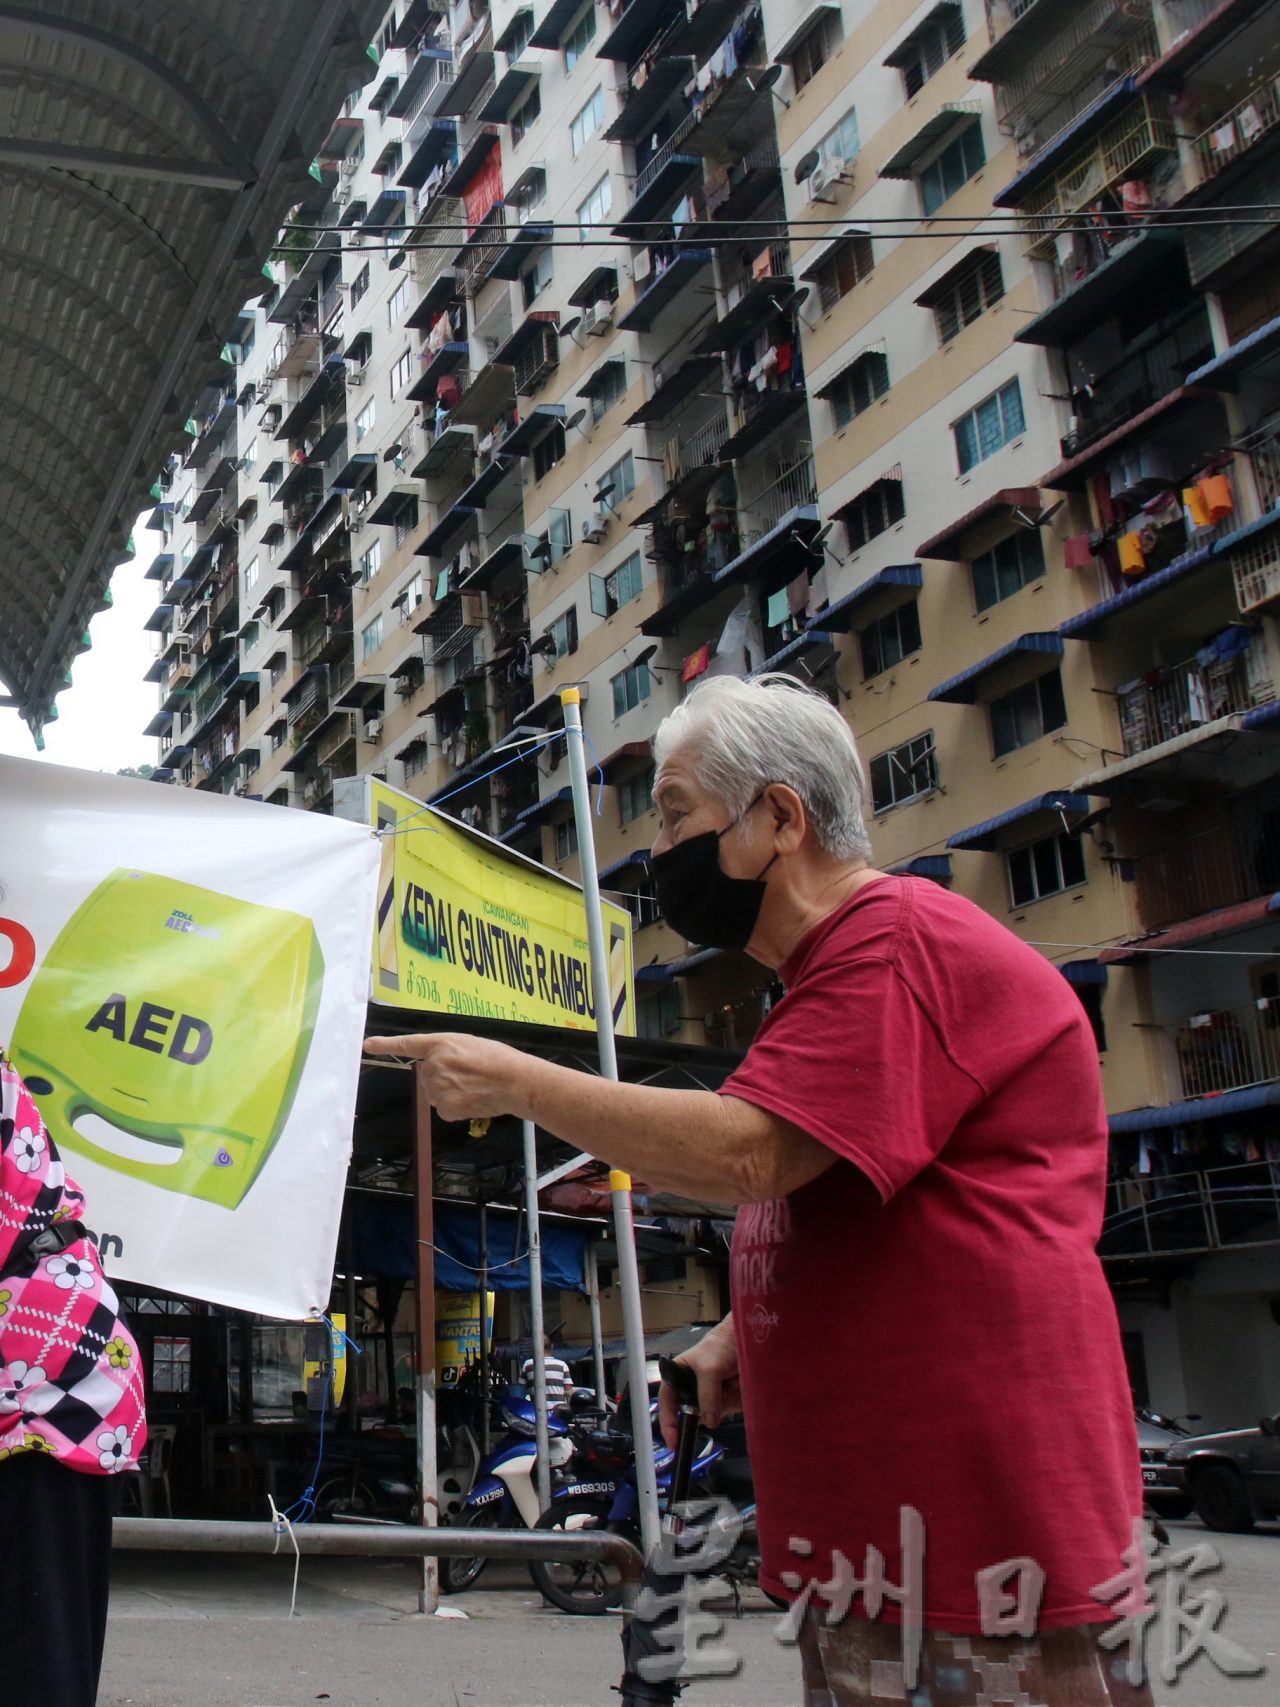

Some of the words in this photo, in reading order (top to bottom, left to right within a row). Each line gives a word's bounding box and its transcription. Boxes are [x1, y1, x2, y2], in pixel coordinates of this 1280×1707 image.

[171, 908, 194, 922] ZOLL
[482, 900, 529, 934] (CAWANGAN)
[401, 880, 457, 965] KEDAI
[458, 908, 535, 997] GUNTING
[536, 942, 596, 1020] RAMBU
[84, 992, 214, 1066] AED
[568, 1482, 615, 1495] WB6930S
